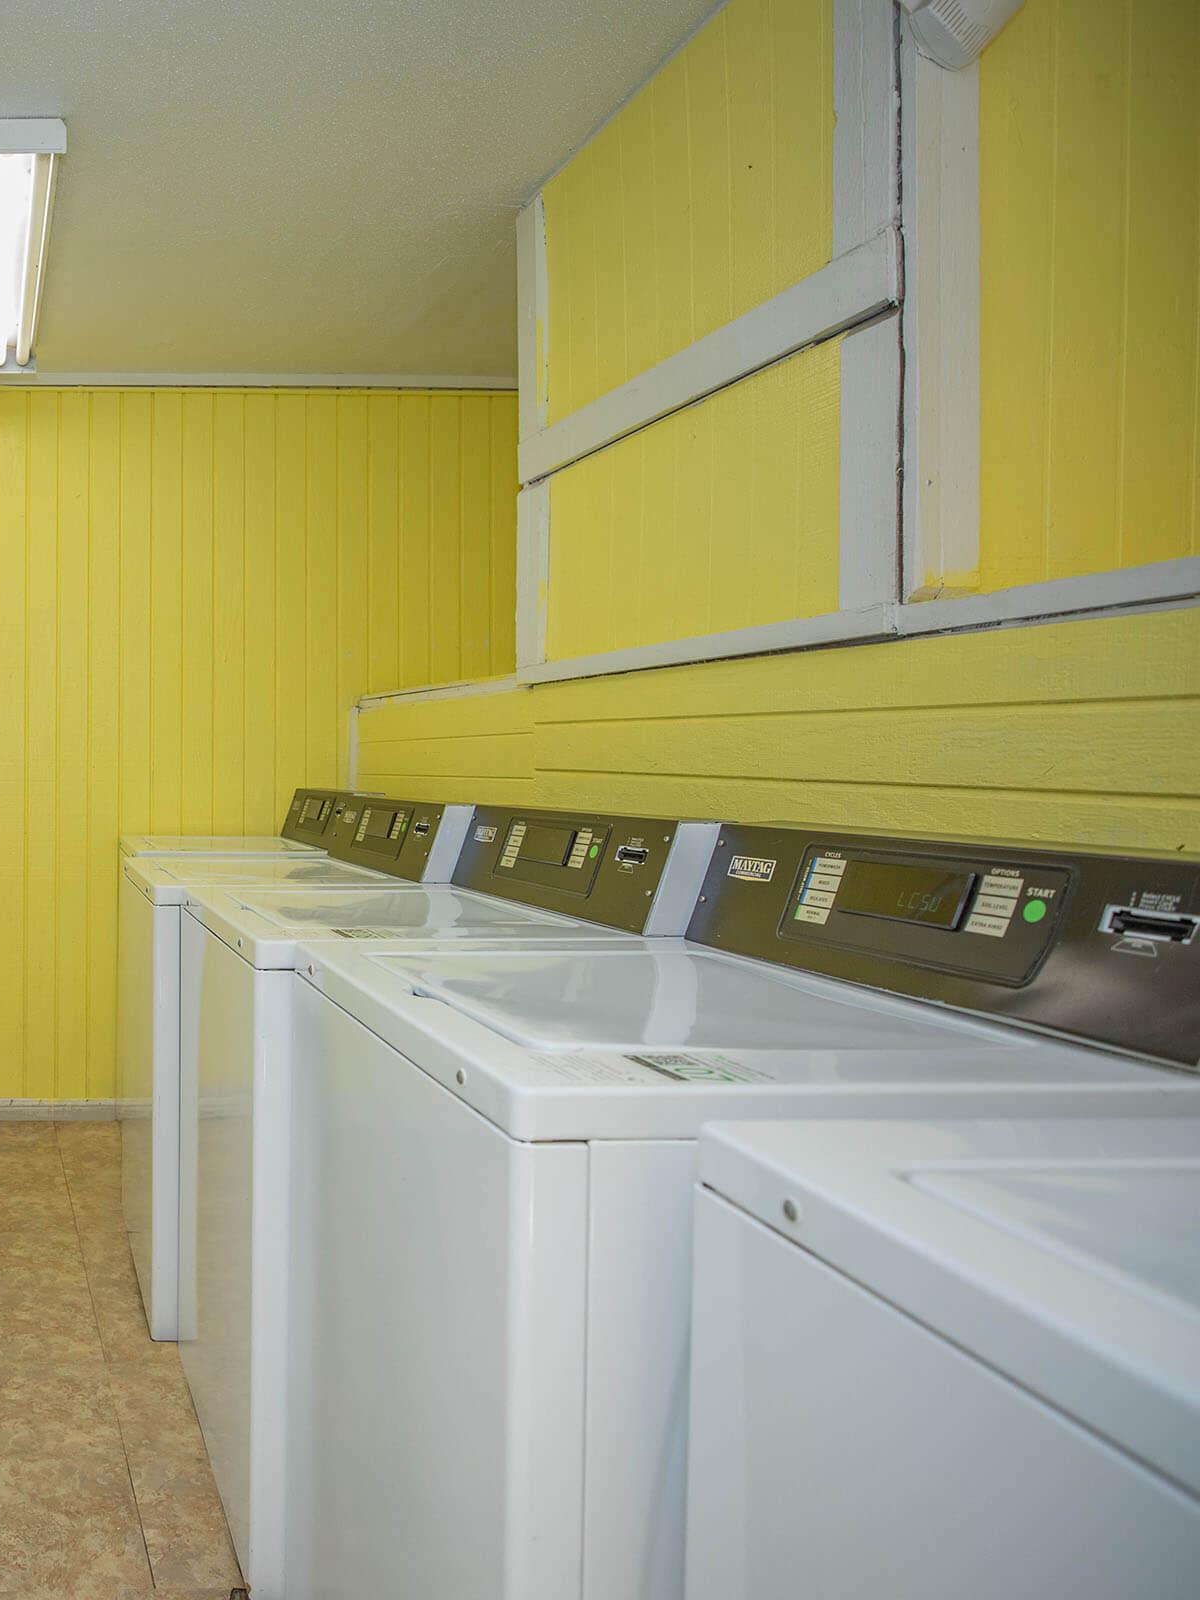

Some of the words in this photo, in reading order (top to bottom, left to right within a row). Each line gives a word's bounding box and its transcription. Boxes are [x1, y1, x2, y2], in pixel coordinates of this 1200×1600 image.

[732, 859, 772, 873] MAYTAG
[991, 867, 1020, 877] OPTIONS
[1026, 887, 1056, 898] START
